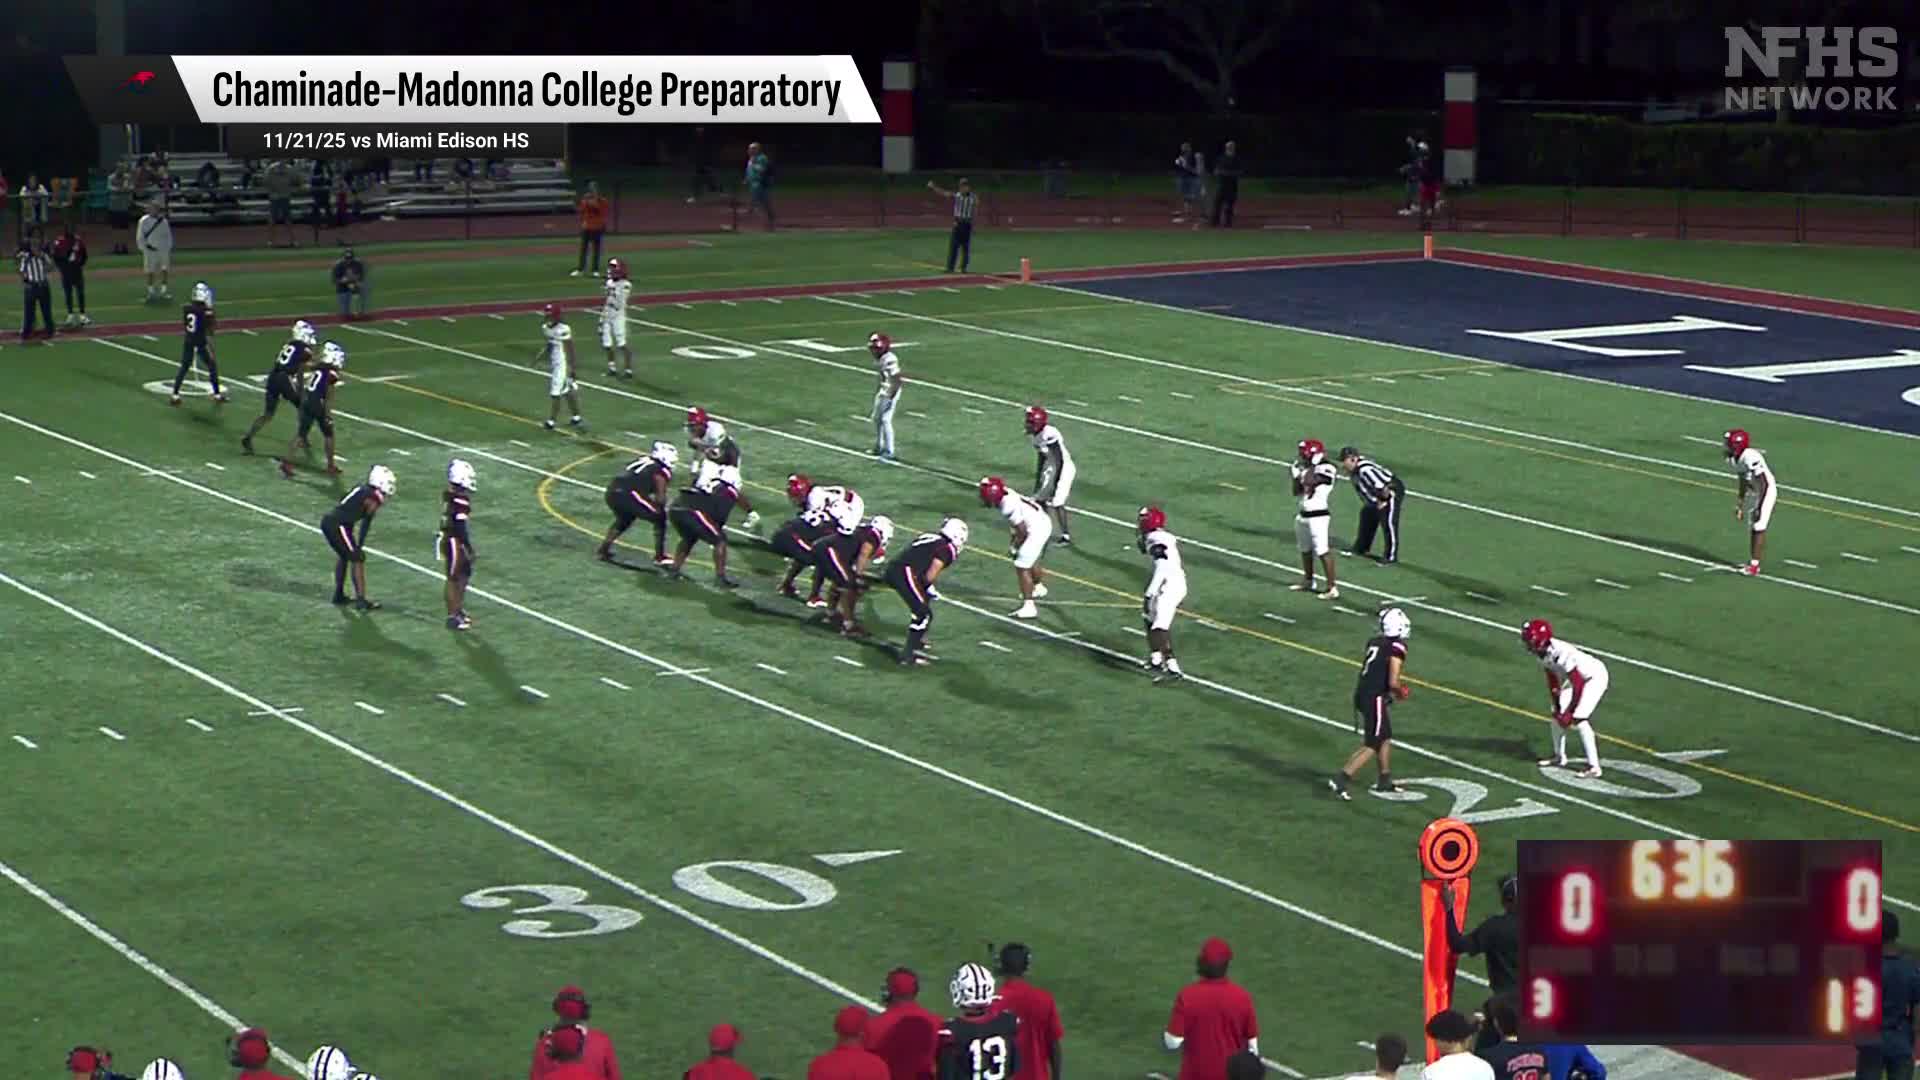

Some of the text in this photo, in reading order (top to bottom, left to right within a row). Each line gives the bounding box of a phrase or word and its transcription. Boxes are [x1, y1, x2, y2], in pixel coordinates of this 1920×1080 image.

[186, 313, 197, 332] 3
[1368, 757, 1702, 824] 20
[461, 860, 838, 938] 30
[1561, 873, 1593, 932] 0
[1847, 869, 1880, 931] 0
[1533, 978, 1552, 1018] 3
[969, 1035, 1006, 1080] 13
